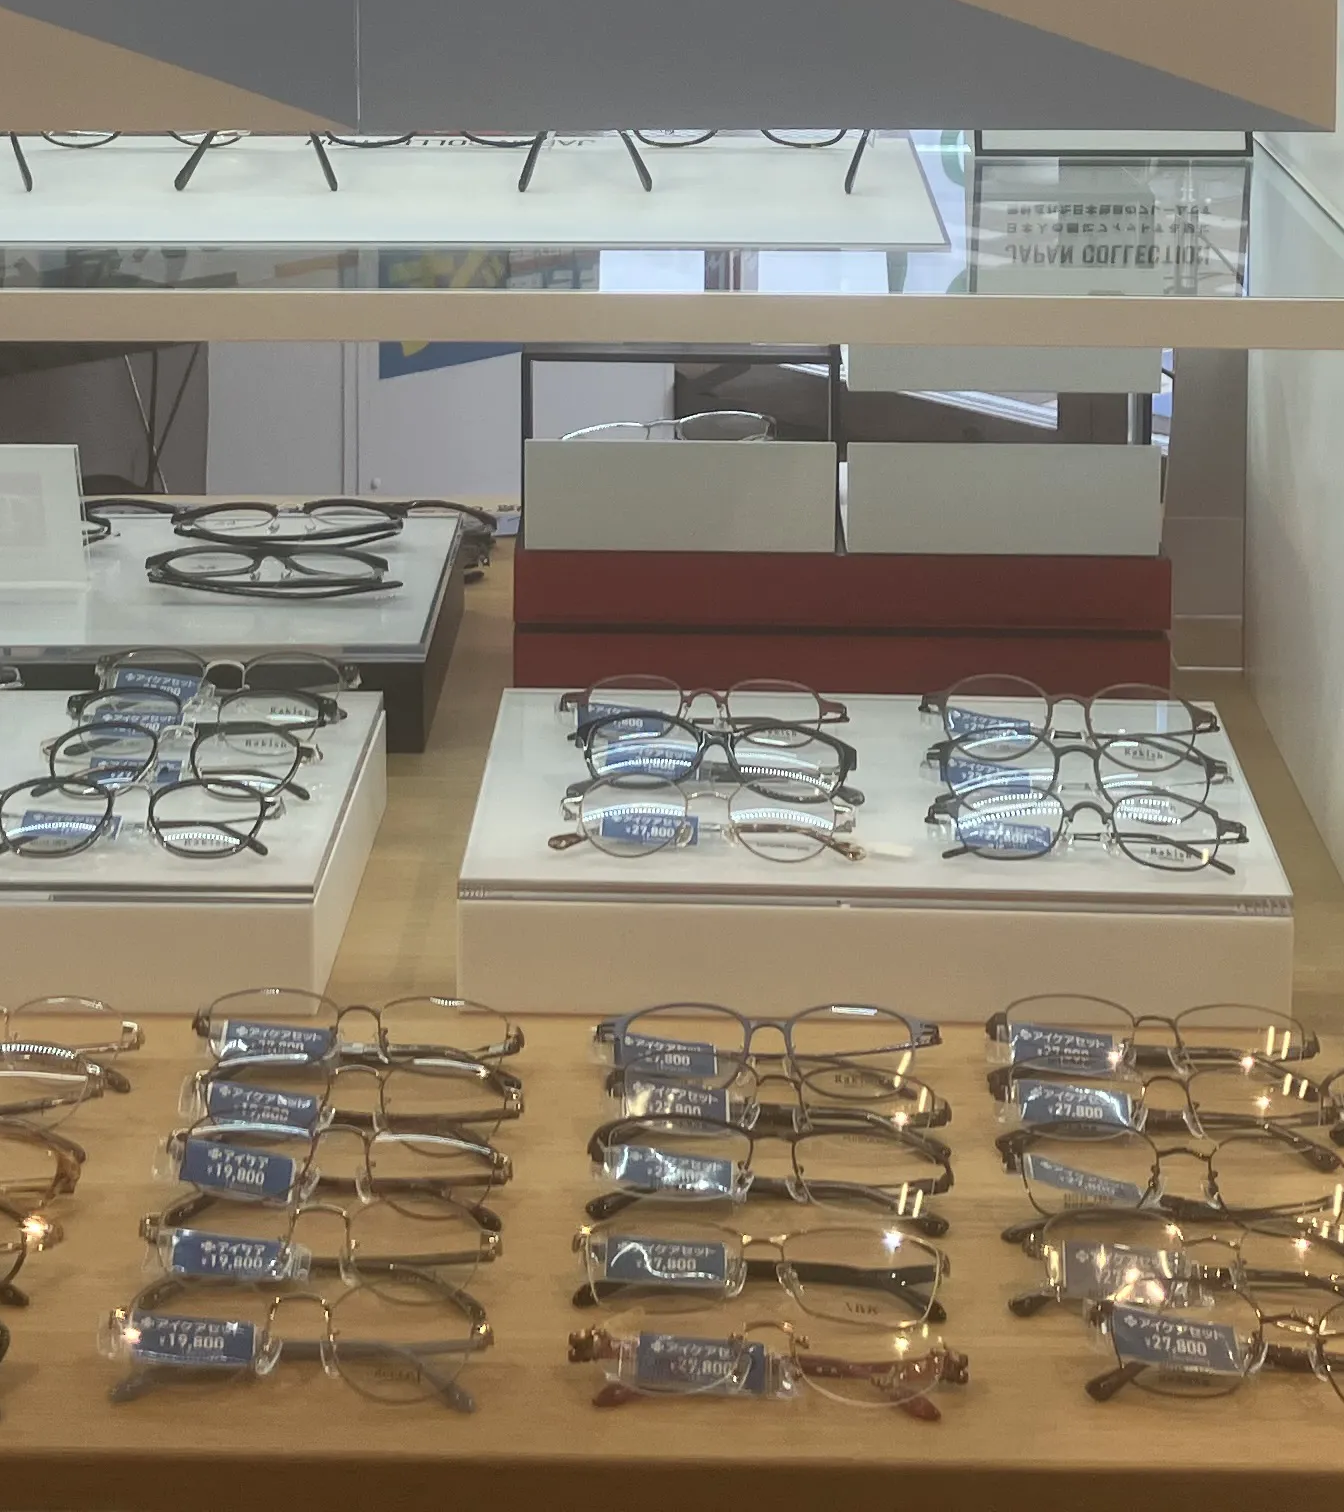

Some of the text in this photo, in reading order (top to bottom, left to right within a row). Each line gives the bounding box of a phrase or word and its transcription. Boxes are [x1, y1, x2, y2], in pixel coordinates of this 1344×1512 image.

[1049, 1104, 1105, 1120] ¥27,800
[207, 1164, 265, 1186] ¥19,800
[201, 1254, 264, 1271] ¥19,800
[158, 1333, 225, 1352] ¥19,800
[664, 1340, 734, 1358] アイケアセ
[1145, 1335, 1208, 1357] ¥27,800
